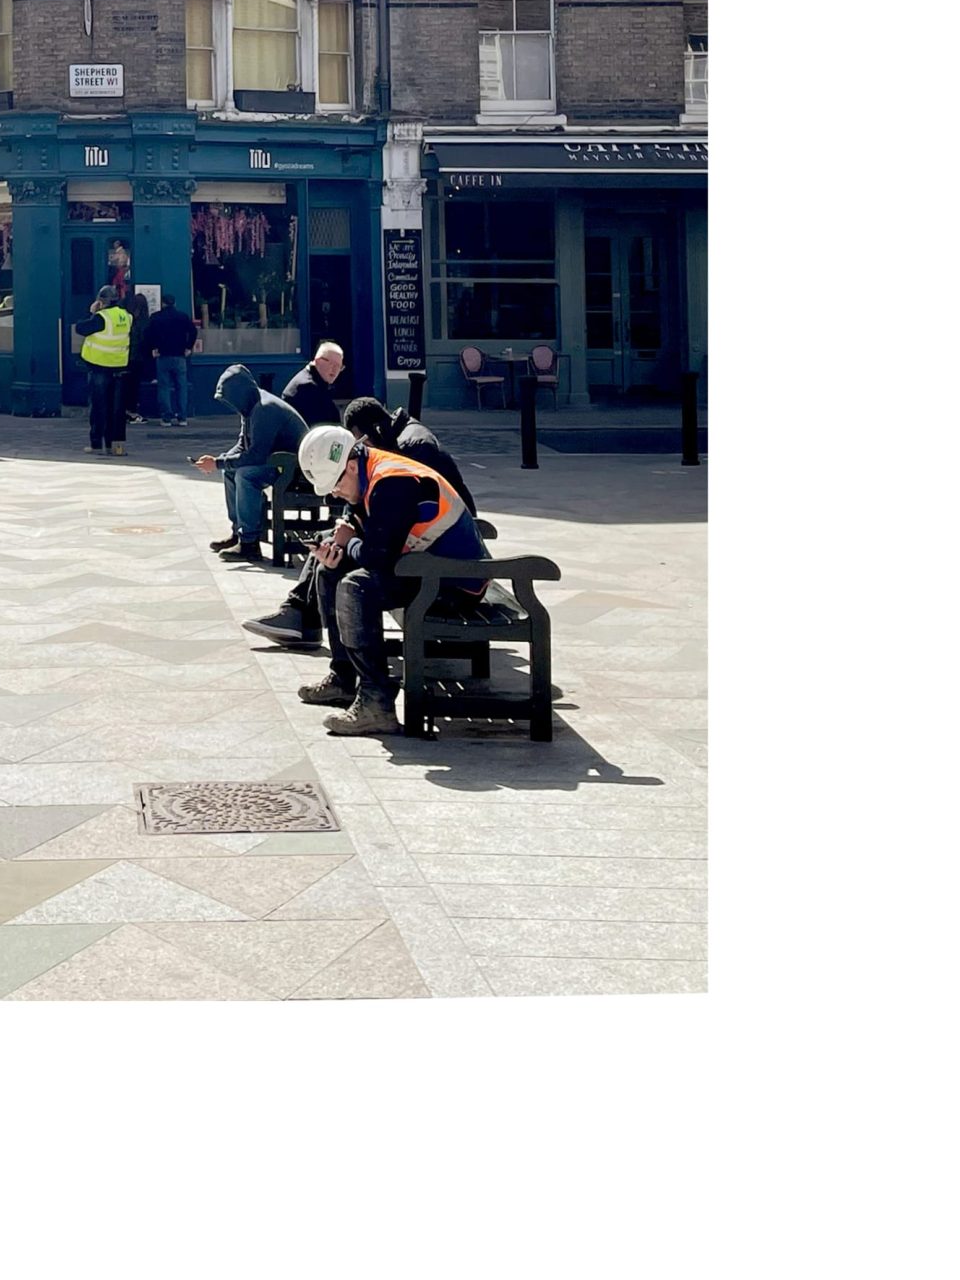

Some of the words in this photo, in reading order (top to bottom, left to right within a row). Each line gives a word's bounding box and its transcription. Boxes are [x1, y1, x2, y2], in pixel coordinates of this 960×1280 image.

[74, 67, 118, 77] SHEPHERD
[74, 77, 105, 87] STREET
[106, 77, 118, 86] W1
[450, 174, 485, 187] CAFFE
[491, 174, 502, 187] IN
[390, 283, 416, 291] GOOD
[390, 291, 419, 300] HEALTHY
[390, 301, 416, 309] FOOD
[397, 355, 422, 368] Enjoy
